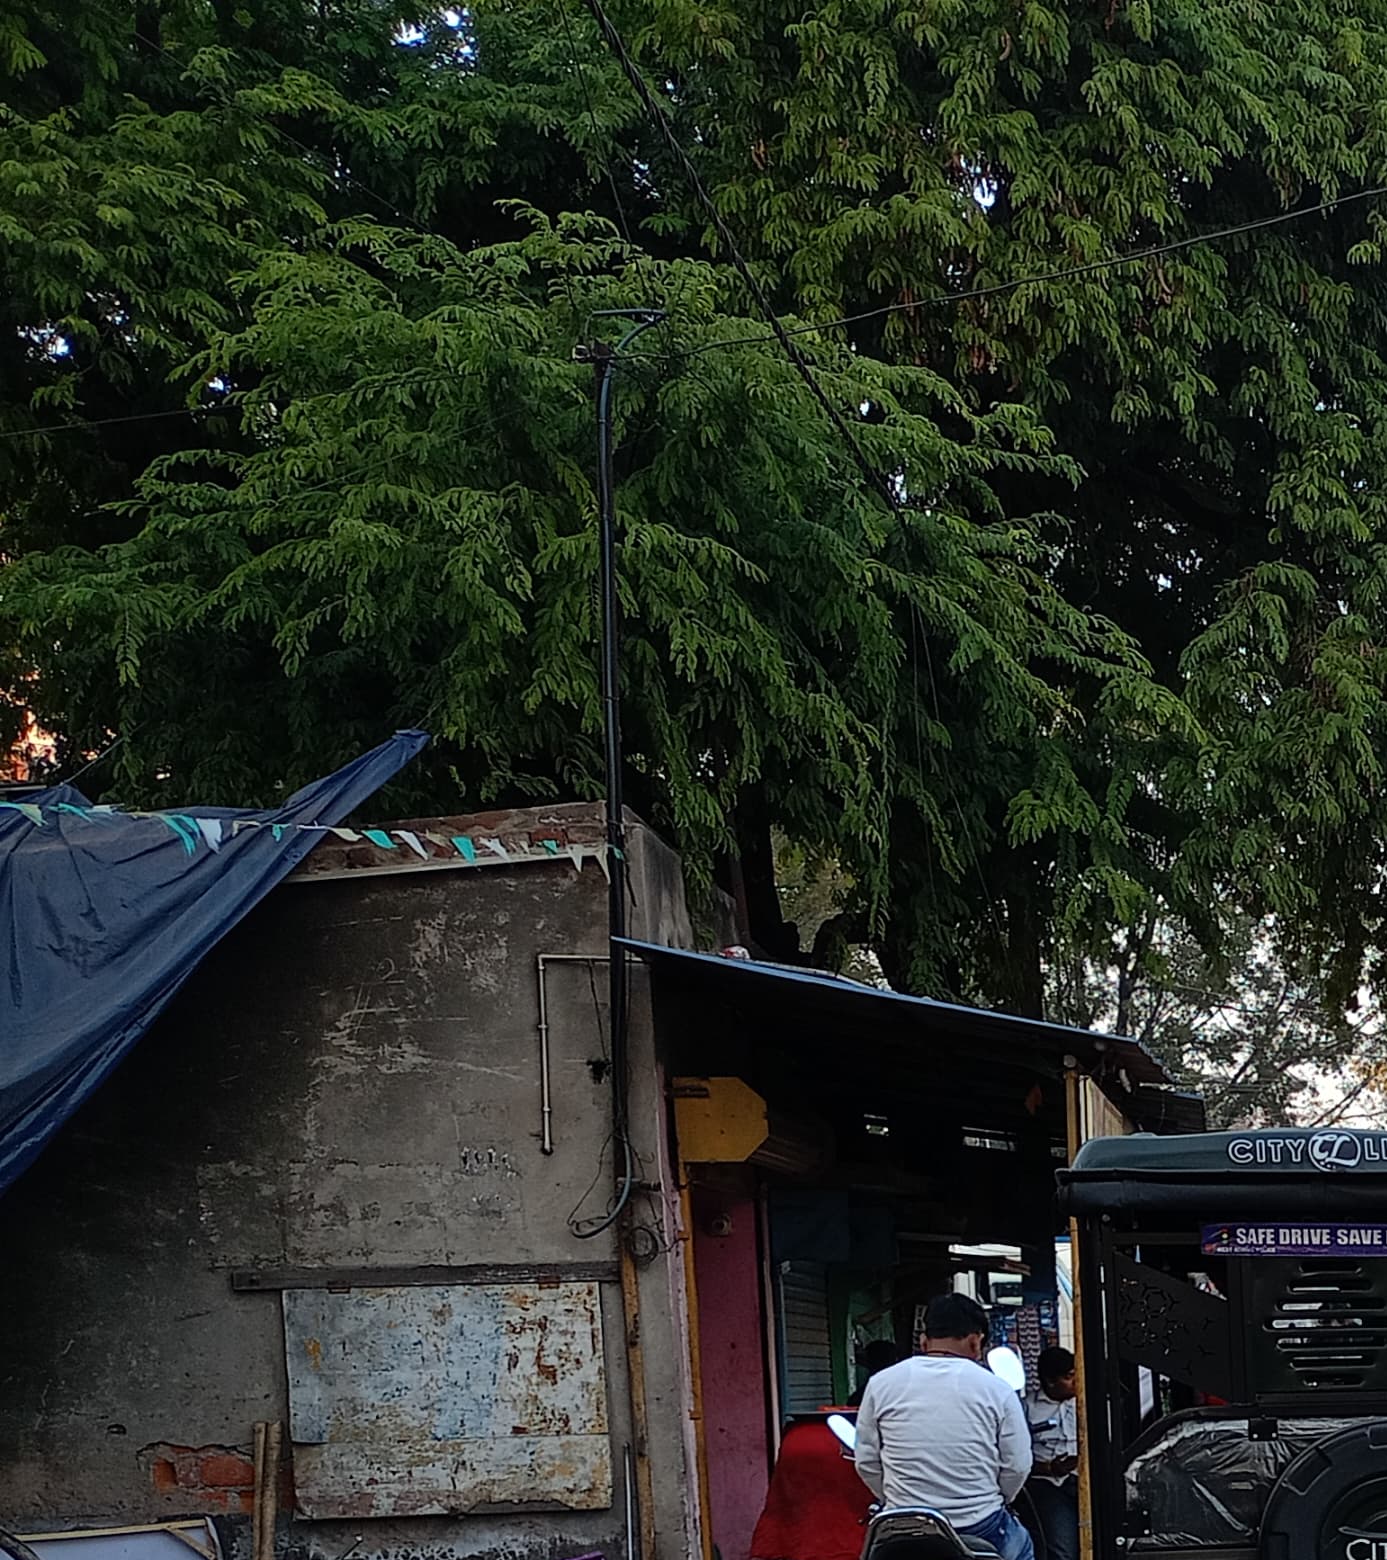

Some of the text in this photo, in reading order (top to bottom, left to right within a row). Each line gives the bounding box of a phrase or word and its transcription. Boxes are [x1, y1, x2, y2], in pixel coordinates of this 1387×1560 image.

[1228, 1138, 1306, 1164] CITY
[1236, 1228, 1275, 1245] SAFE
[1279, 1228, 1331, 1245] DRIVE
[1337, 1229, 1382, 1245] SAVE
